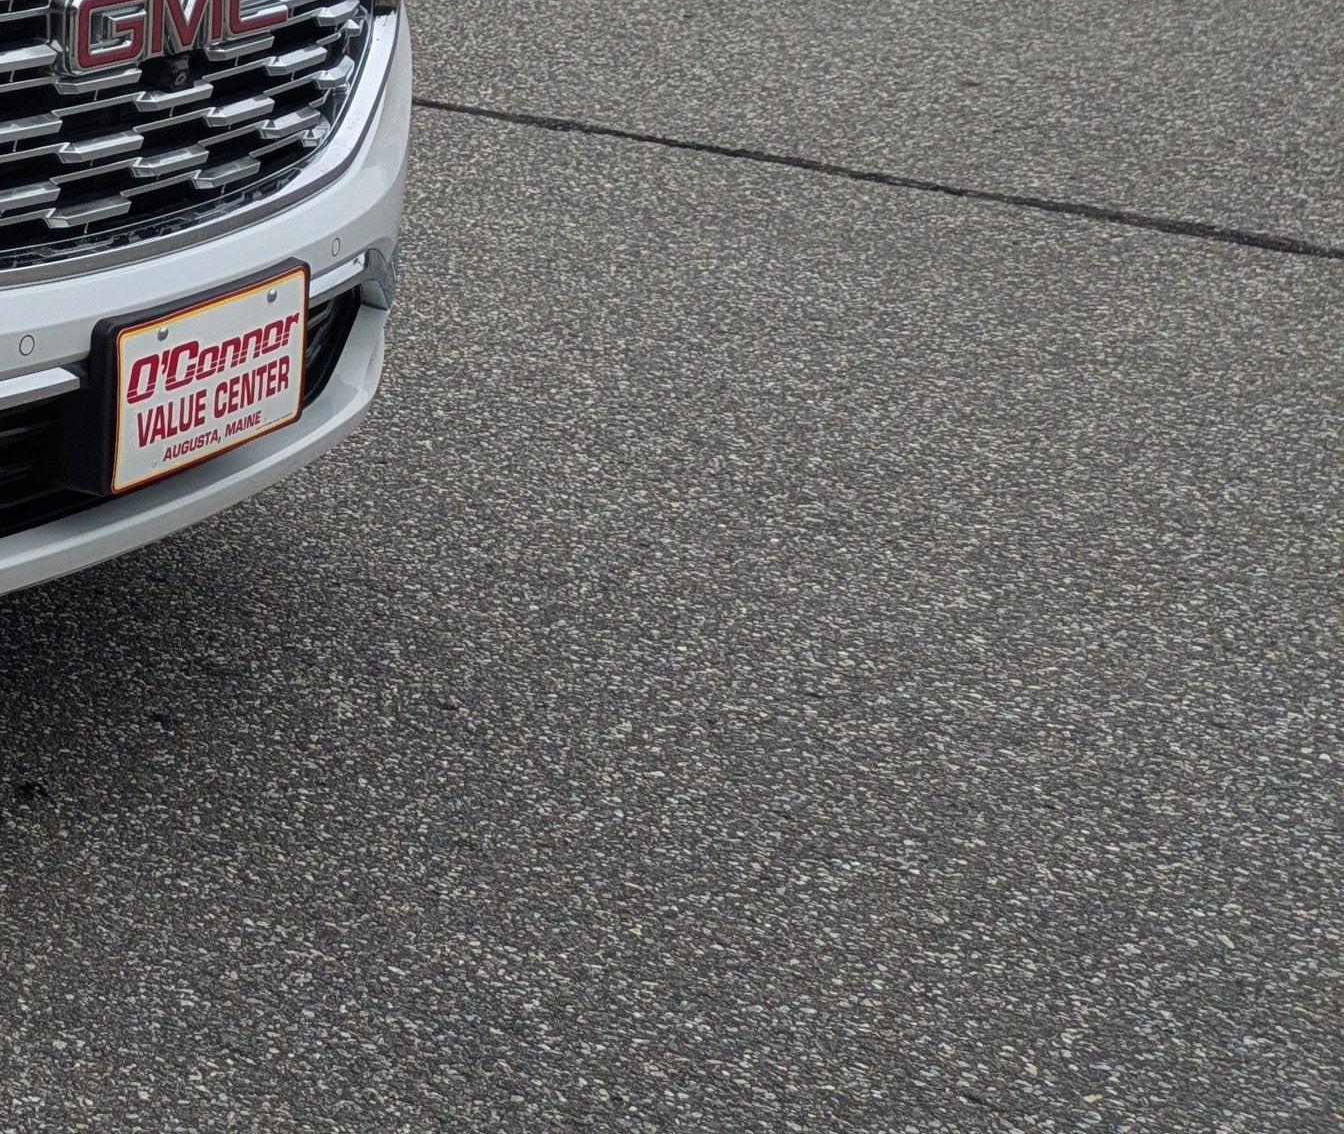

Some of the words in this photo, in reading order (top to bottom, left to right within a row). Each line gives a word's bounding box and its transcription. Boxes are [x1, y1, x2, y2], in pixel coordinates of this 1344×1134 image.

[126, 312, 300, 405] O'Connor
[136, 389, 207, 448] VALUE
[214, 355, 290, 419] CENTER
[163, 430, 222, 463] AUGUSTA,
[224, 411, 262, 438] MAINE
